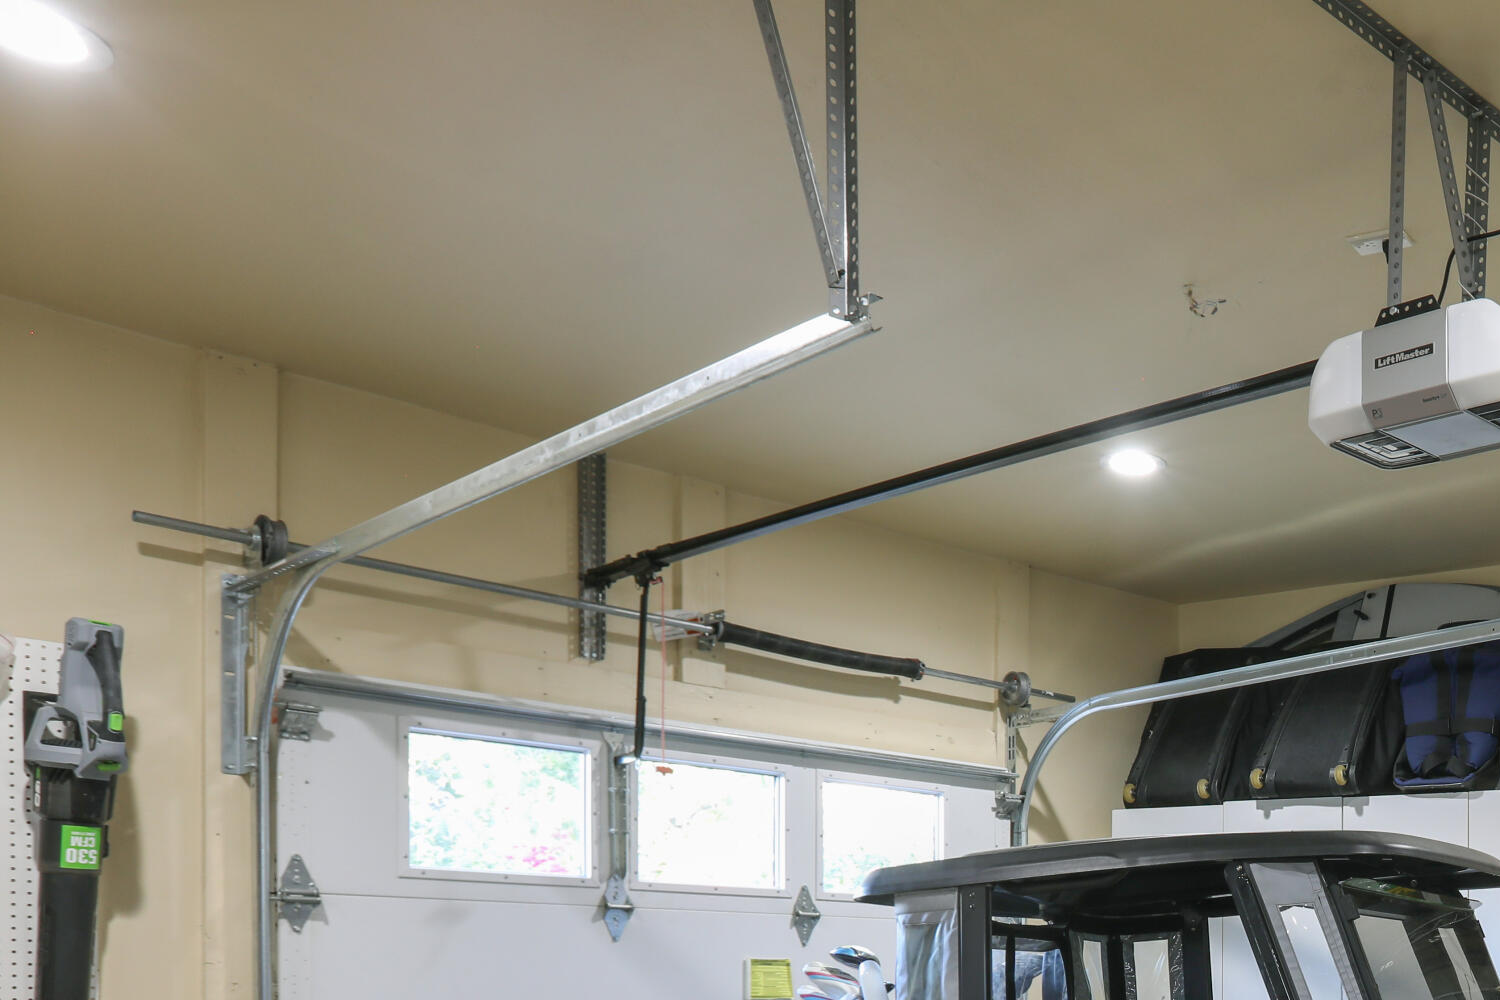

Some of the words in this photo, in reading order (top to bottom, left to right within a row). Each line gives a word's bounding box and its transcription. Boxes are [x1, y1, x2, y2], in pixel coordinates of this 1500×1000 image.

[1377, 347, 1430, 368] LiftMaster
[70, 836, 96, 847] CFM
[65, 848, 98, 864] 530
